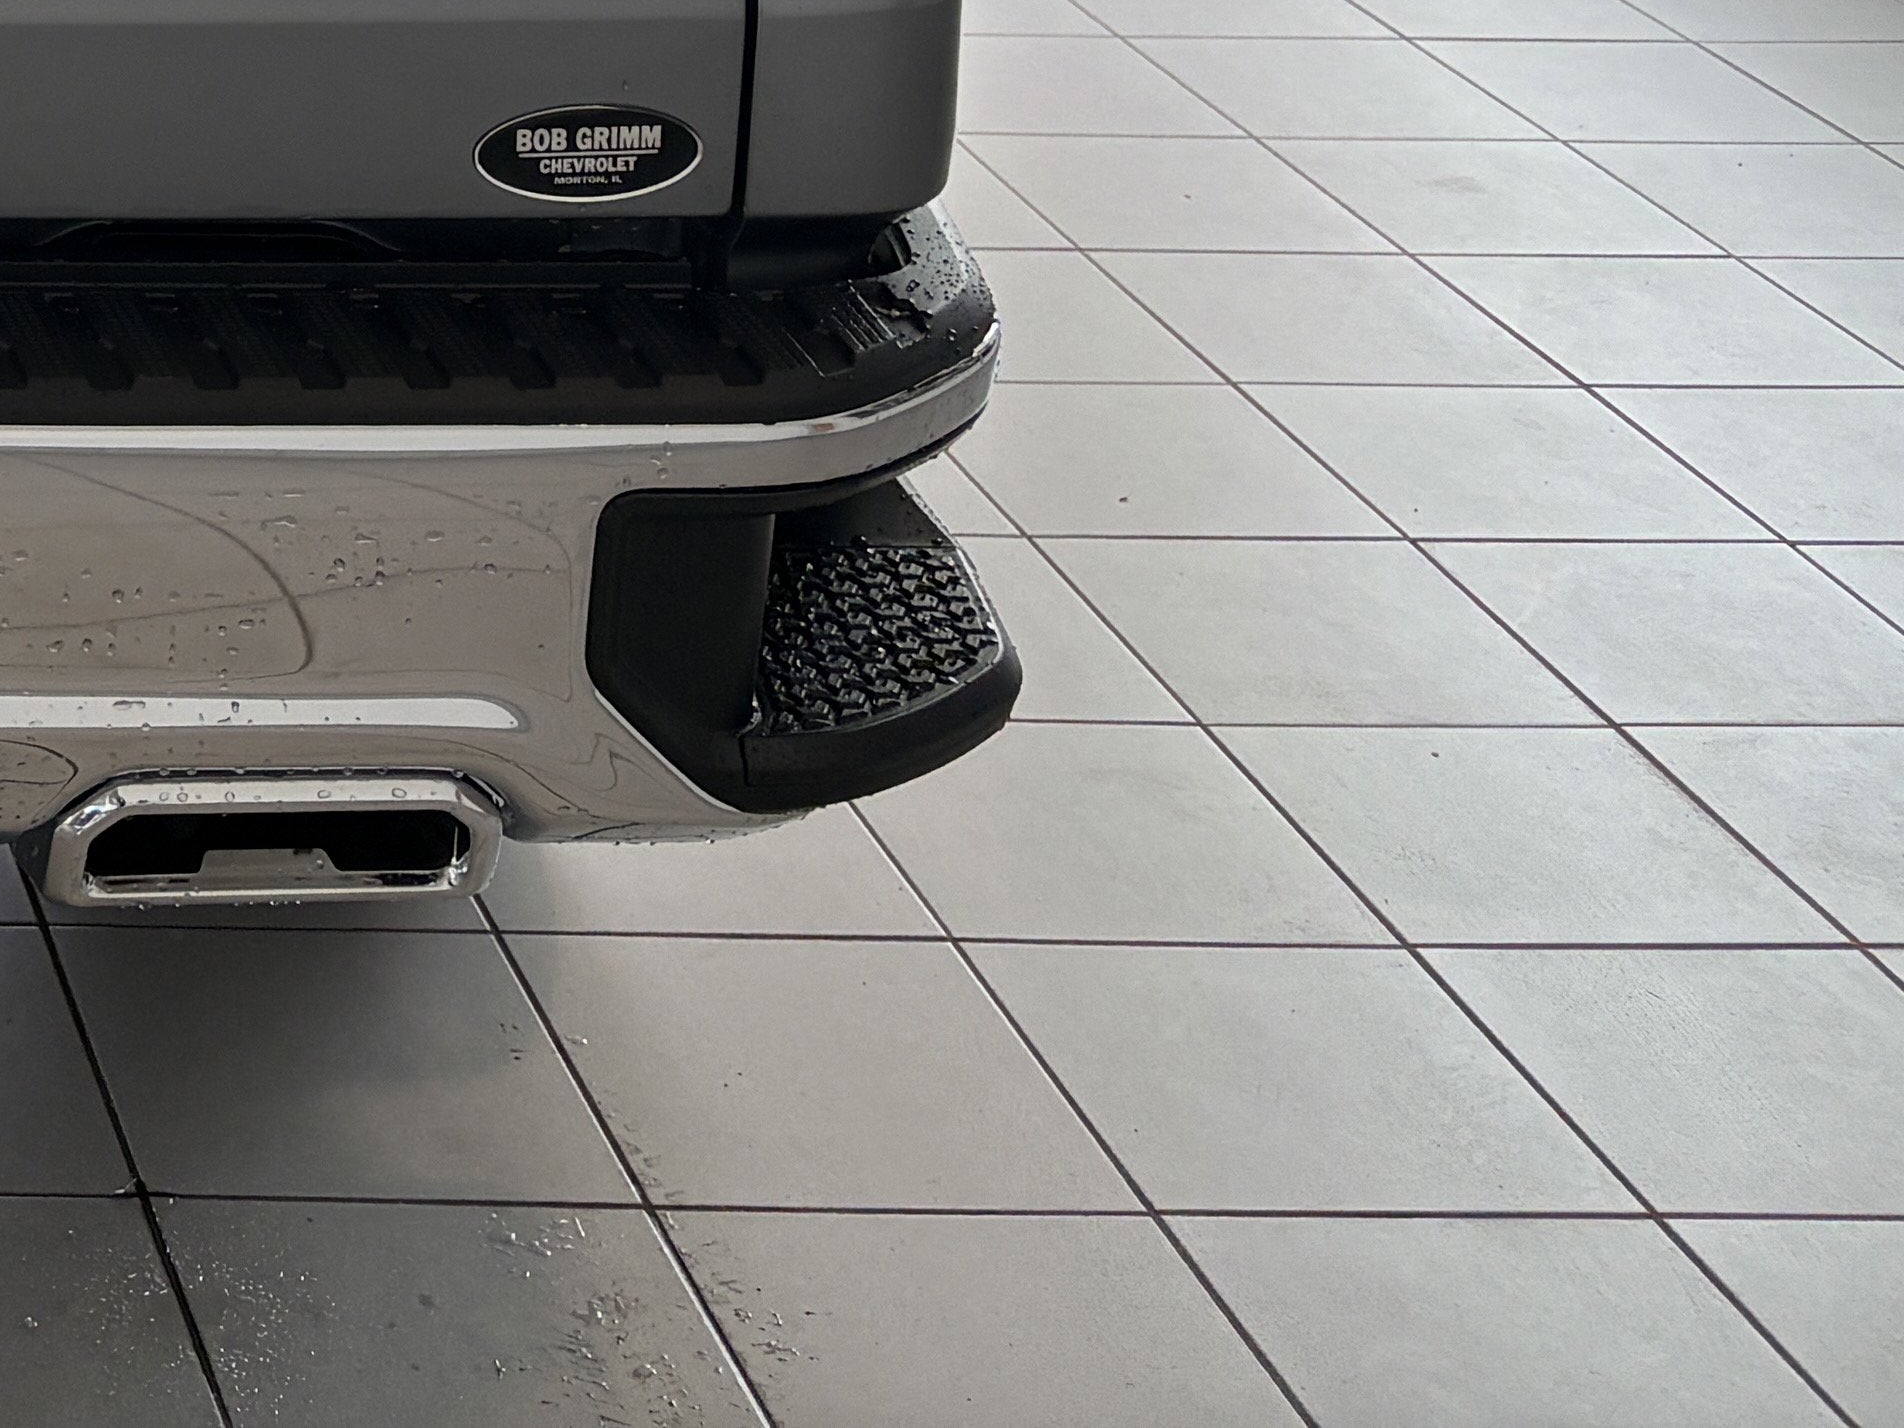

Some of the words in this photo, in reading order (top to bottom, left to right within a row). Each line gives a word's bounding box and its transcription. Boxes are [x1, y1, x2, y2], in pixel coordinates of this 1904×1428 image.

[515, 128, 568, 152] BOB
[575, 125, 662, 150] GRIMM
[539, 156, 638, 174] CHEVROLET
